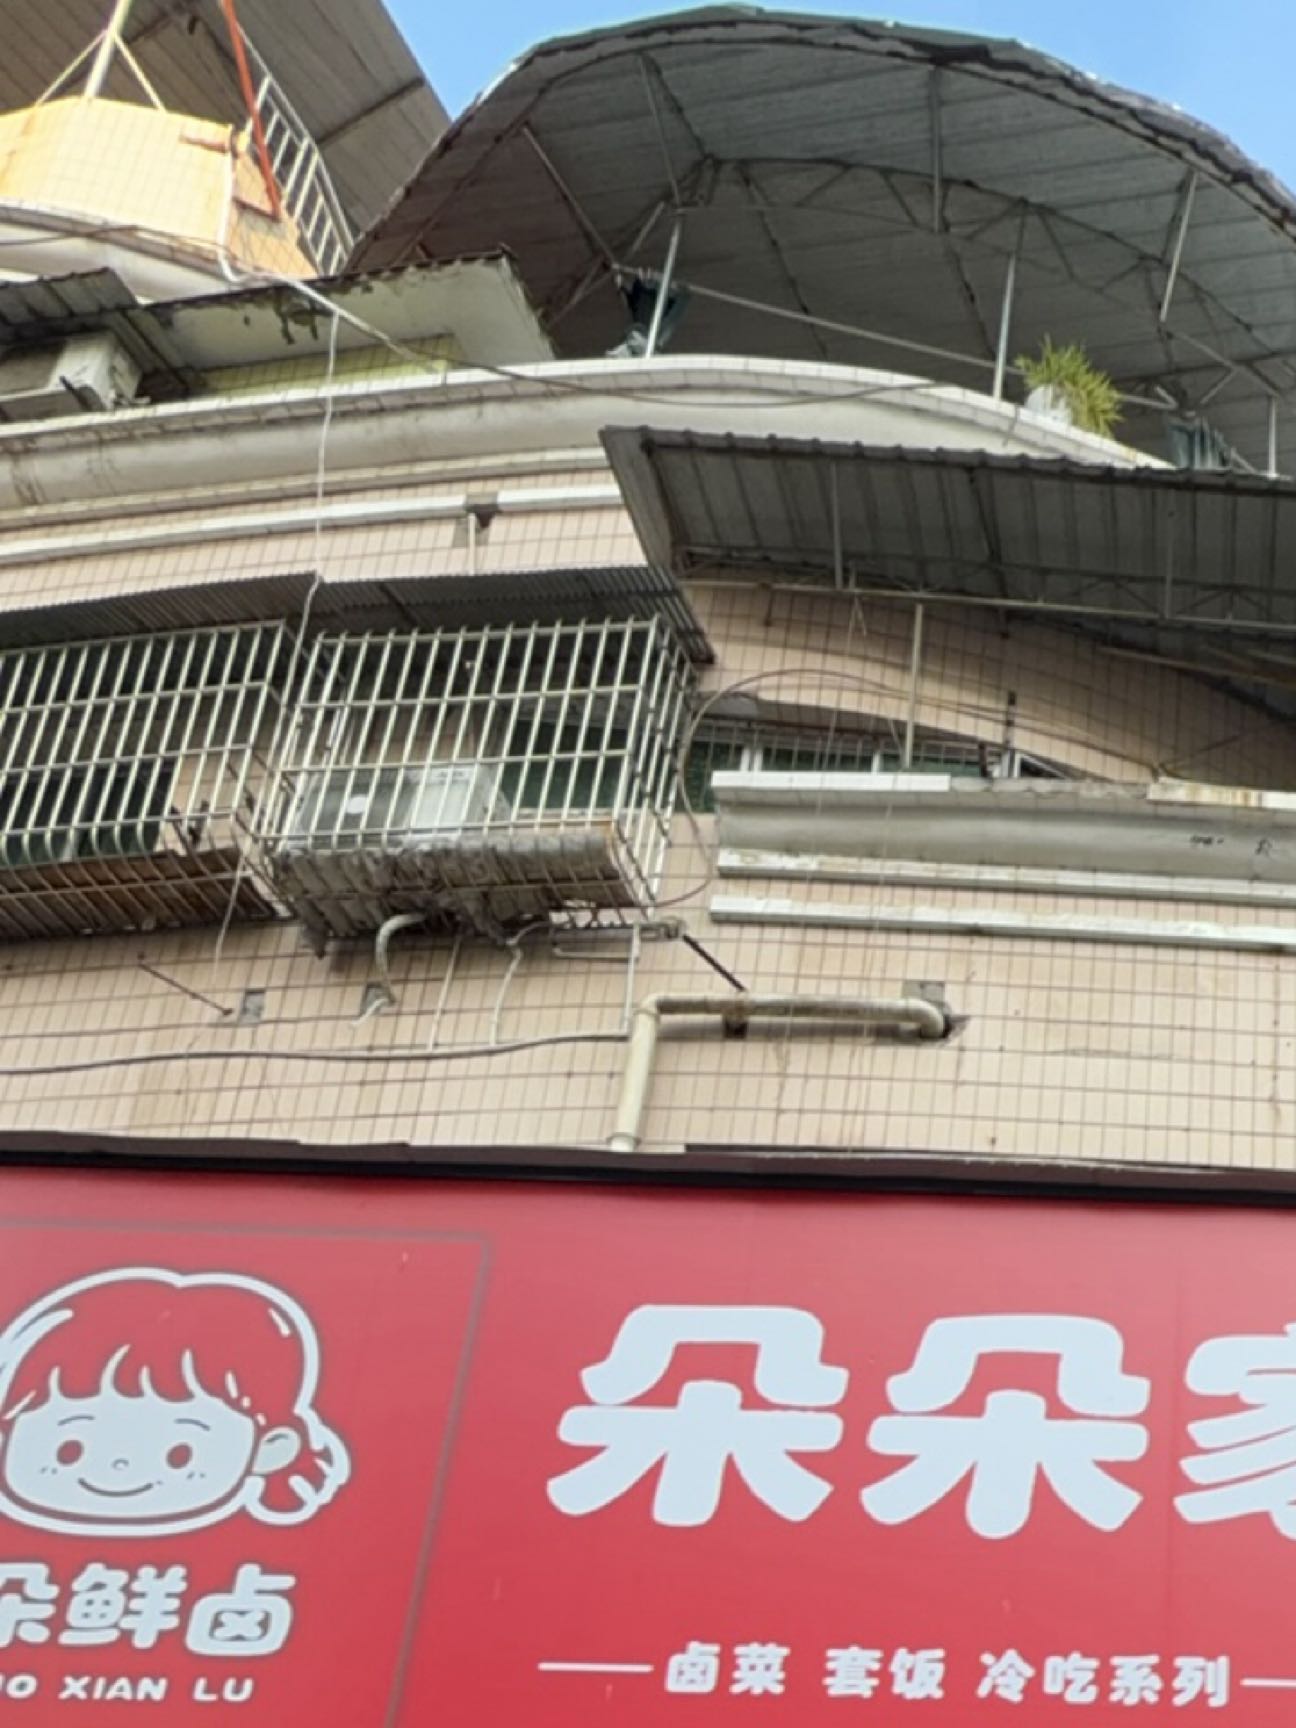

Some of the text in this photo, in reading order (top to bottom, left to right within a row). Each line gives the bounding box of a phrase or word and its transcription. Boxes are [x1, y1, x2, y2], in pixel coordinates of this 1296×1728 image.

[59, 1676, 168, 1701] XIAN
[194, 1678, 254, 1702] LU
[664, 1641, 1231, 1707] 卤菜 套饭 冷吃系列
